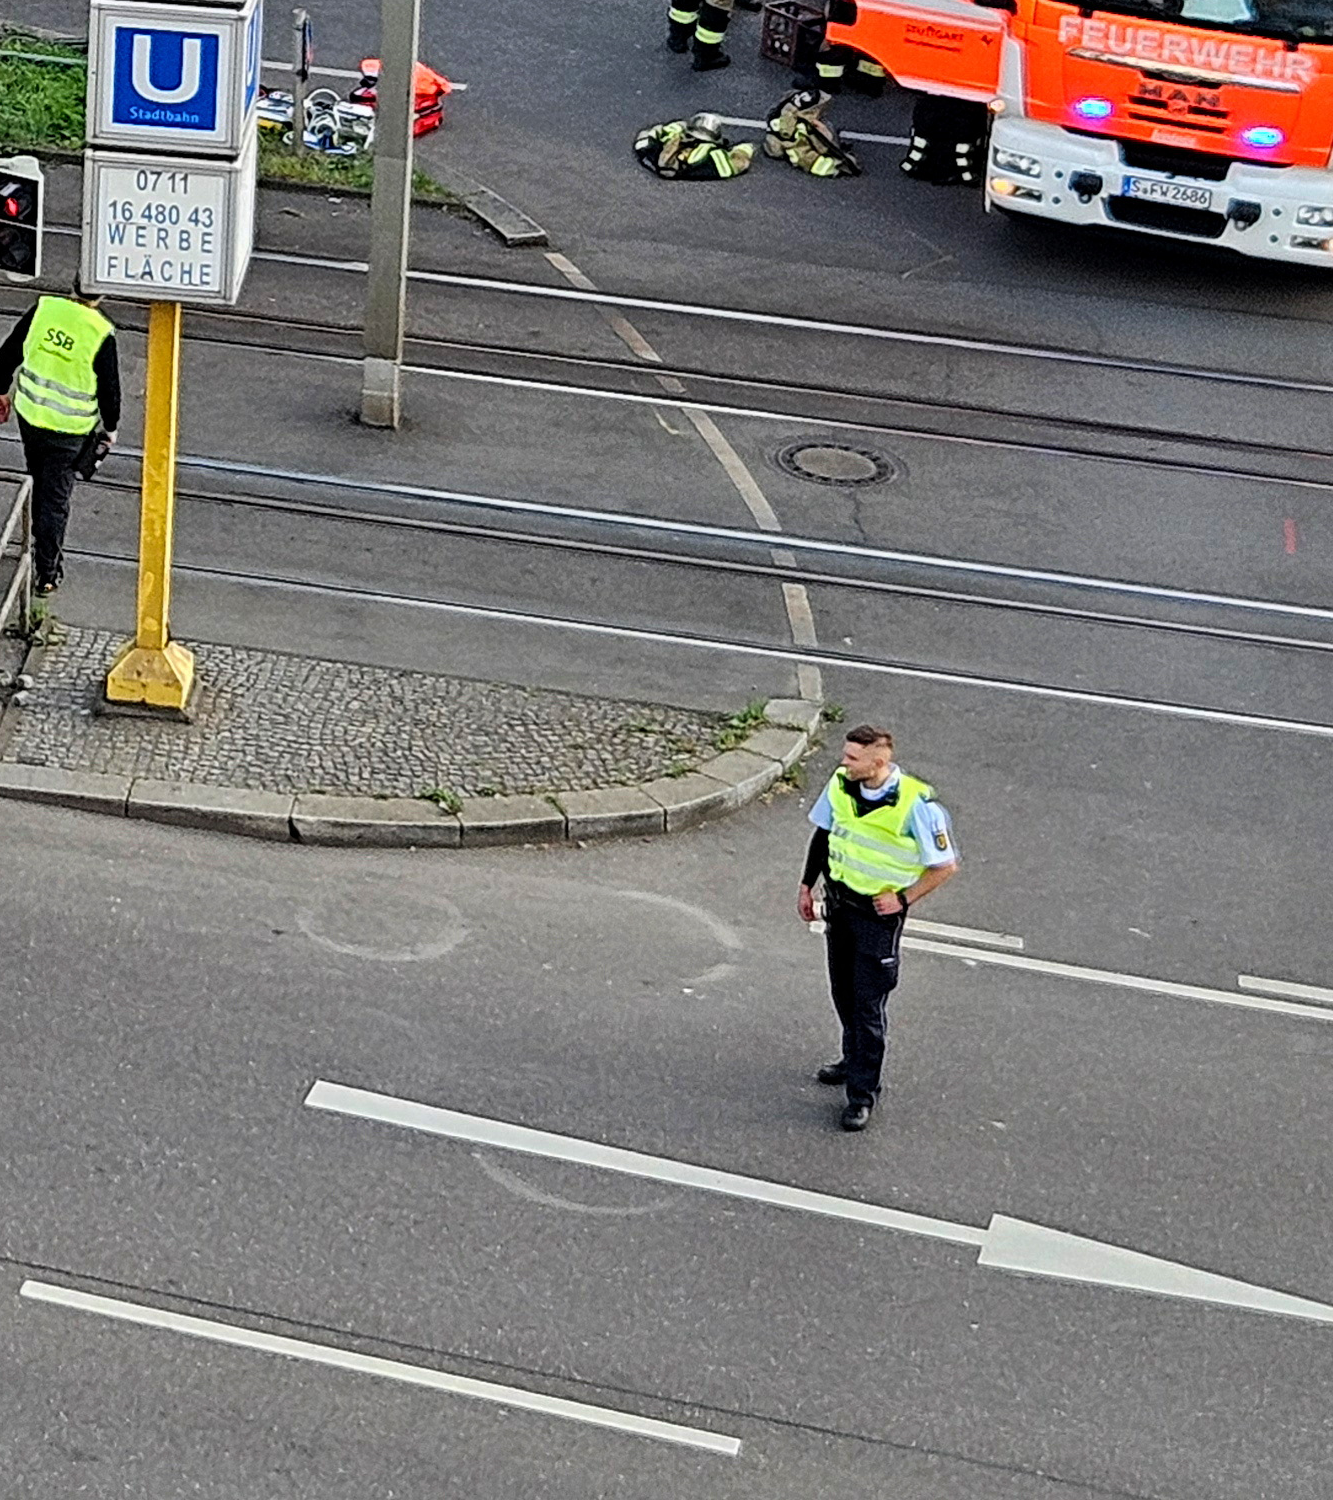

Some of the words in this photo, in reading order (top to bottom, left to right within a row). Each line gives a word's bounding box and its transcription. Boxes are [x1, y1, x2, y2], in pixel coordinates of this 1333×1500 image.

[1058, 16, 1313, 81] FEUERWEHR
[132, 34, 202, 104] U
[1138, 83, 1221, 107] MAN
[130, 106, 200, 124] Stadtbahn
[136, 169, 189, 194] 0711
[1171, 187, 1207, 204] 2686
[109, 199, 134, 222] 16
[141, 203, 181, 226] 480
[188, 206, 214, 228] 43
[108, 223, 213, 253] WERBE
[107, 254, 212, 286] FLÄCHE
[44, 328, 75, 351] SSB
